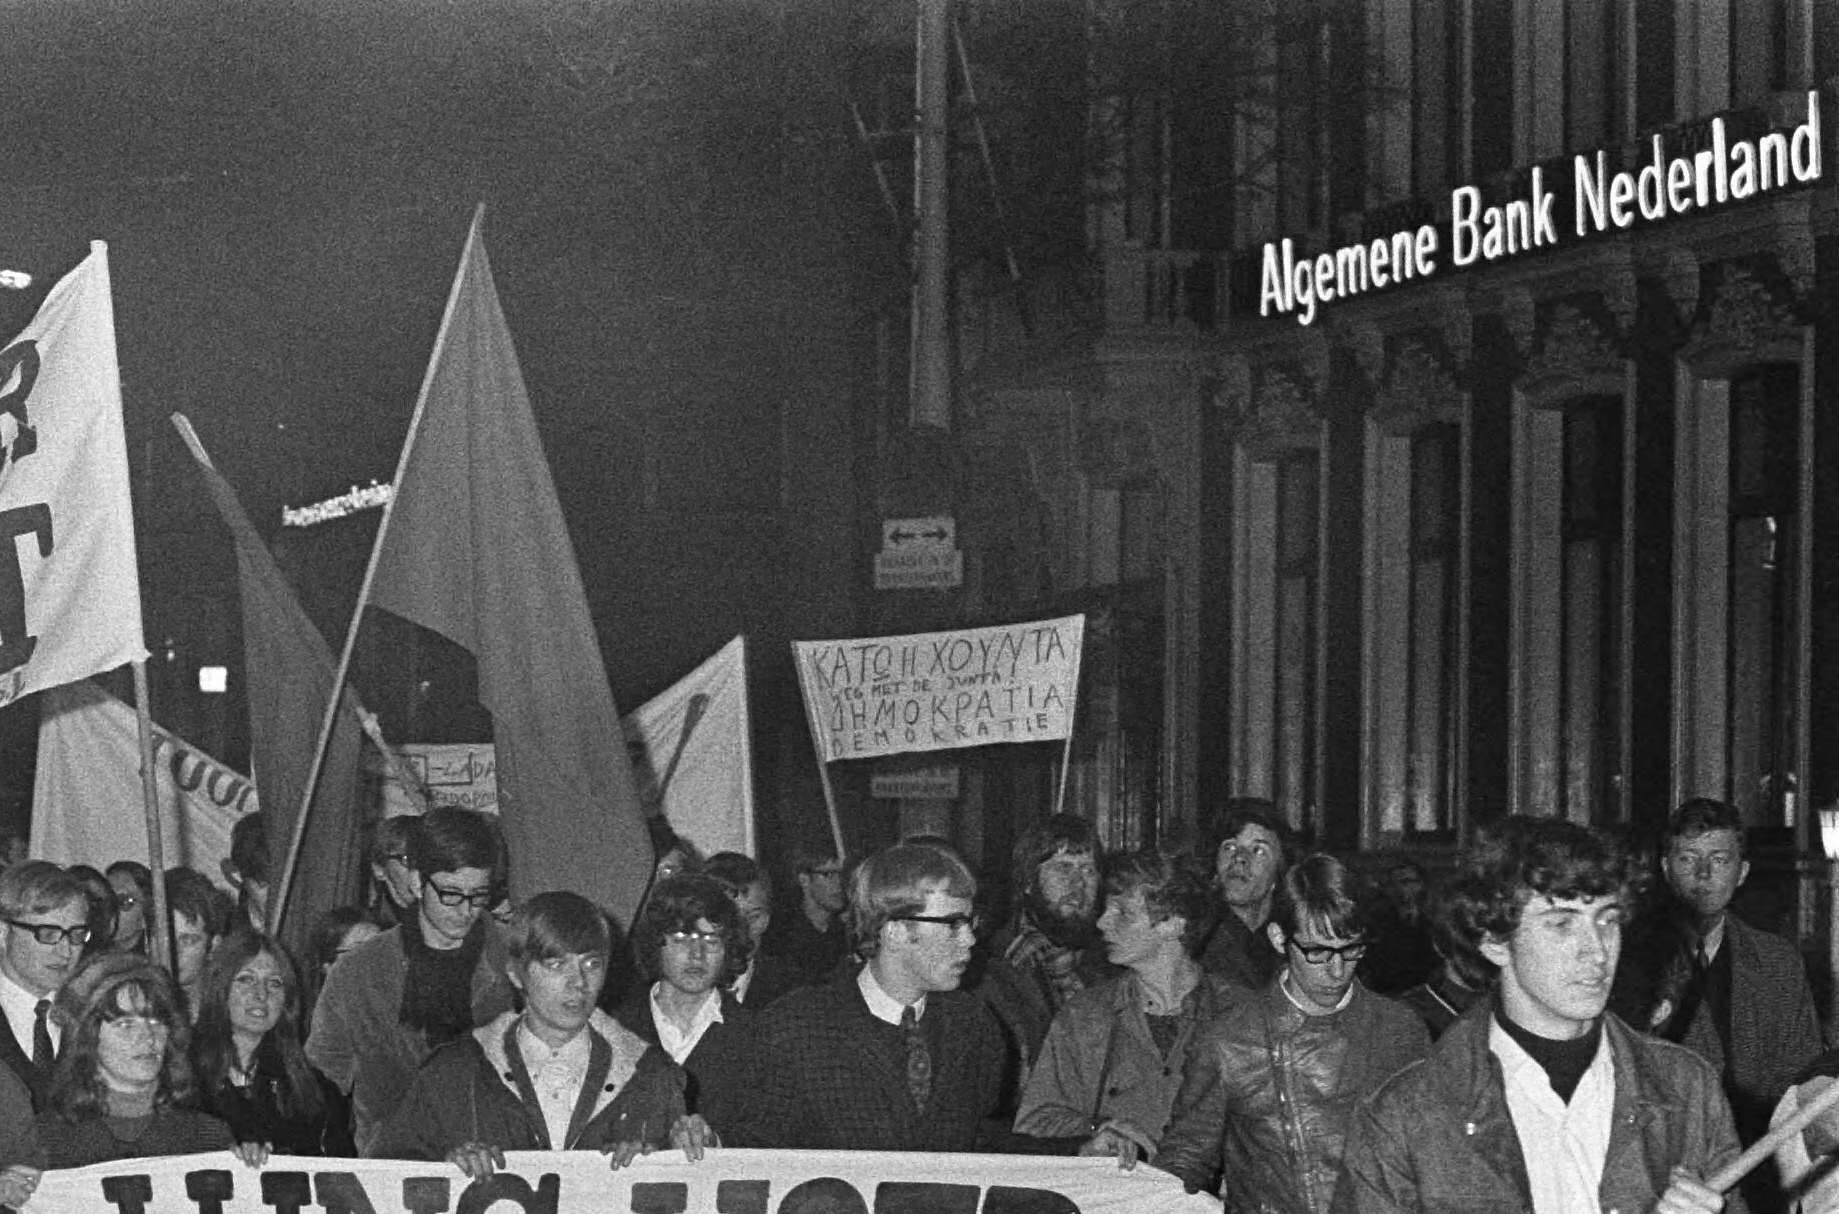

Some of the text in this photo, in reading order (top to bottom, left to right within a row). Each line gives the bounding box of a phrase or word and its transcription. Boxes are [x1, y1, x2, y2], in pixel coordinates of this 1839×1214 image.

[1260, 90, 1823, 326] Algemene Bank Nederland
[832, 713, 1049, 757] DEMOKRATIE
